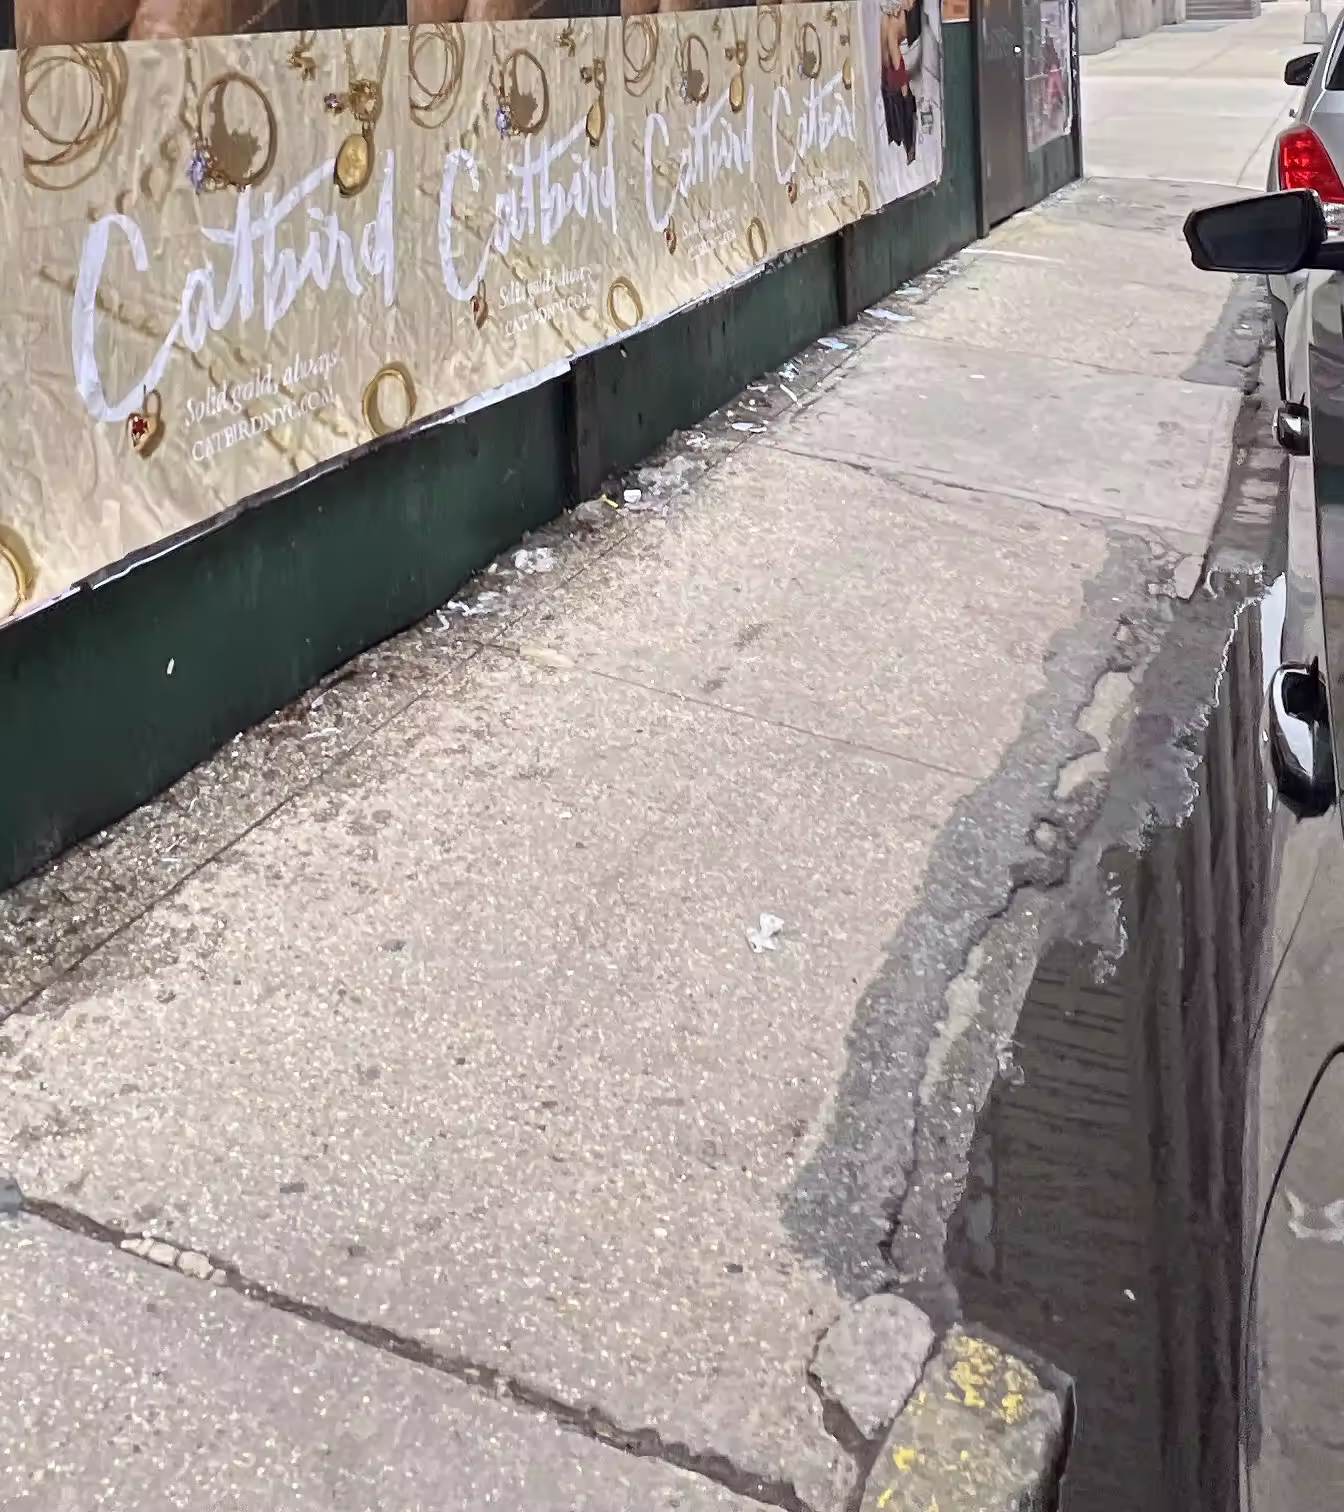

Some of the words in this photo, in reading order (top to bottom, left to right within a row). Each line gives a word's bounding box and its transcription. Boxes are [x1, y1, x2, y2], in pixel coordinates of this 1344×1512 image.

[438, 112, 618, 301] Catbird
[72, 149, 396, 422] Catbird
[186, 379, 228, 424] Solid
[191, 384, 335, 461] CATBIRDNYC.COM
